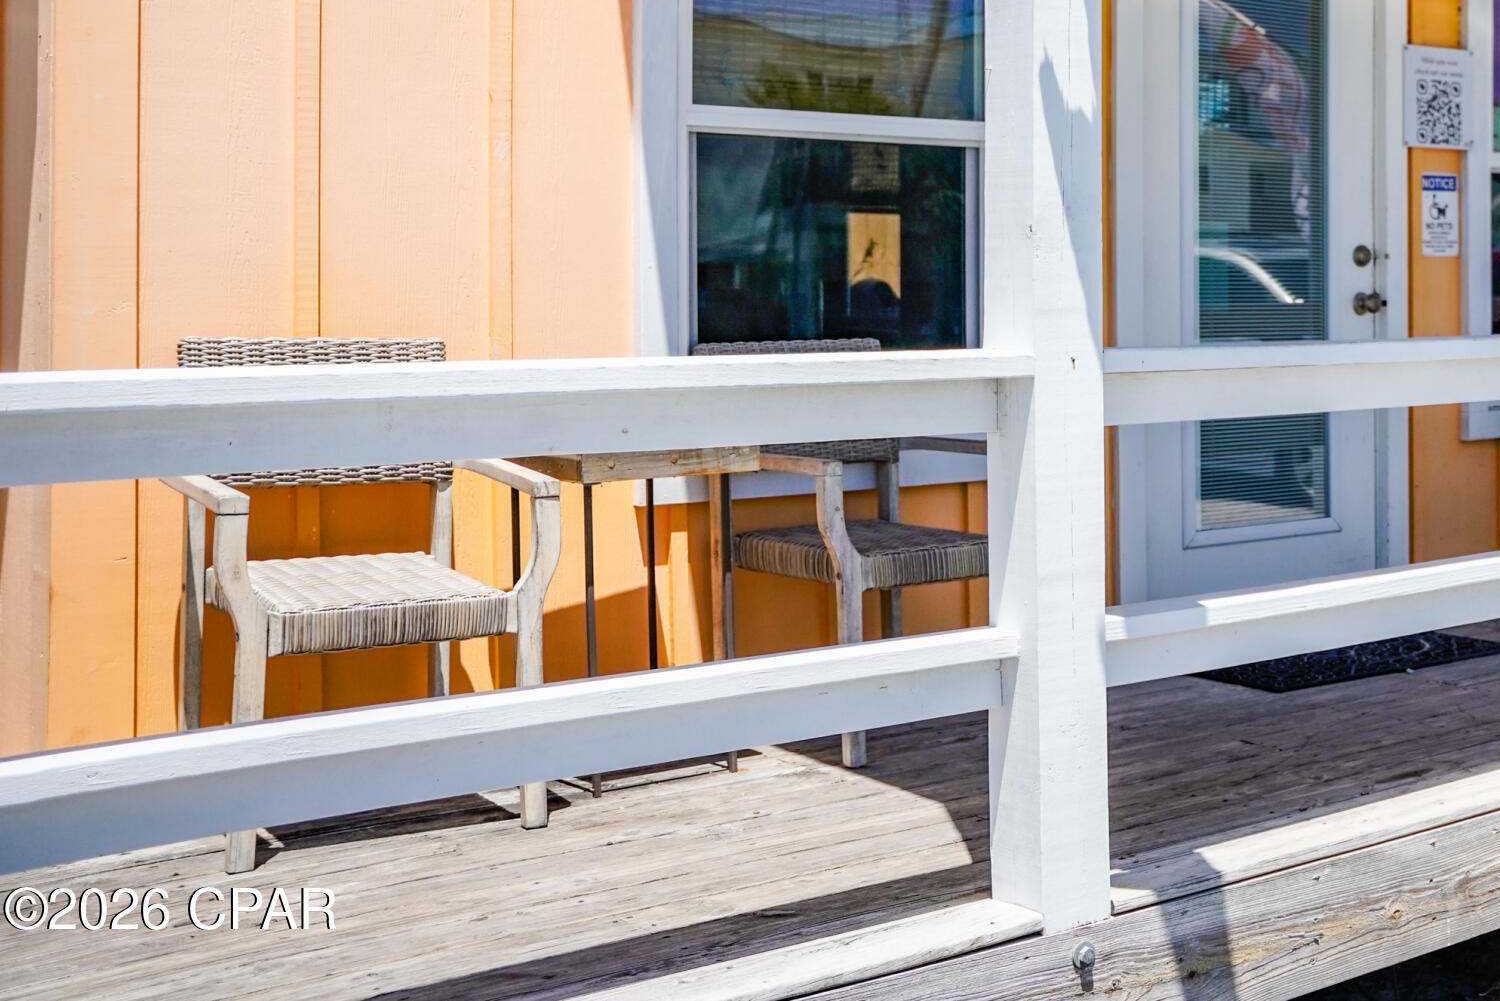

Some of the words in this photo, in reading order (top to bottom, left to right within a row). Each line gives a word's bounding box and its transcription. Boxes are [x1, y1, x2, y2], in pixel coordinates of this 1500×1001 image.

[1422, 178, 1456, 190] NOTICE
[1425, 222, 1435, 231] NO
[1436, 222, 1453, 231] PETS
